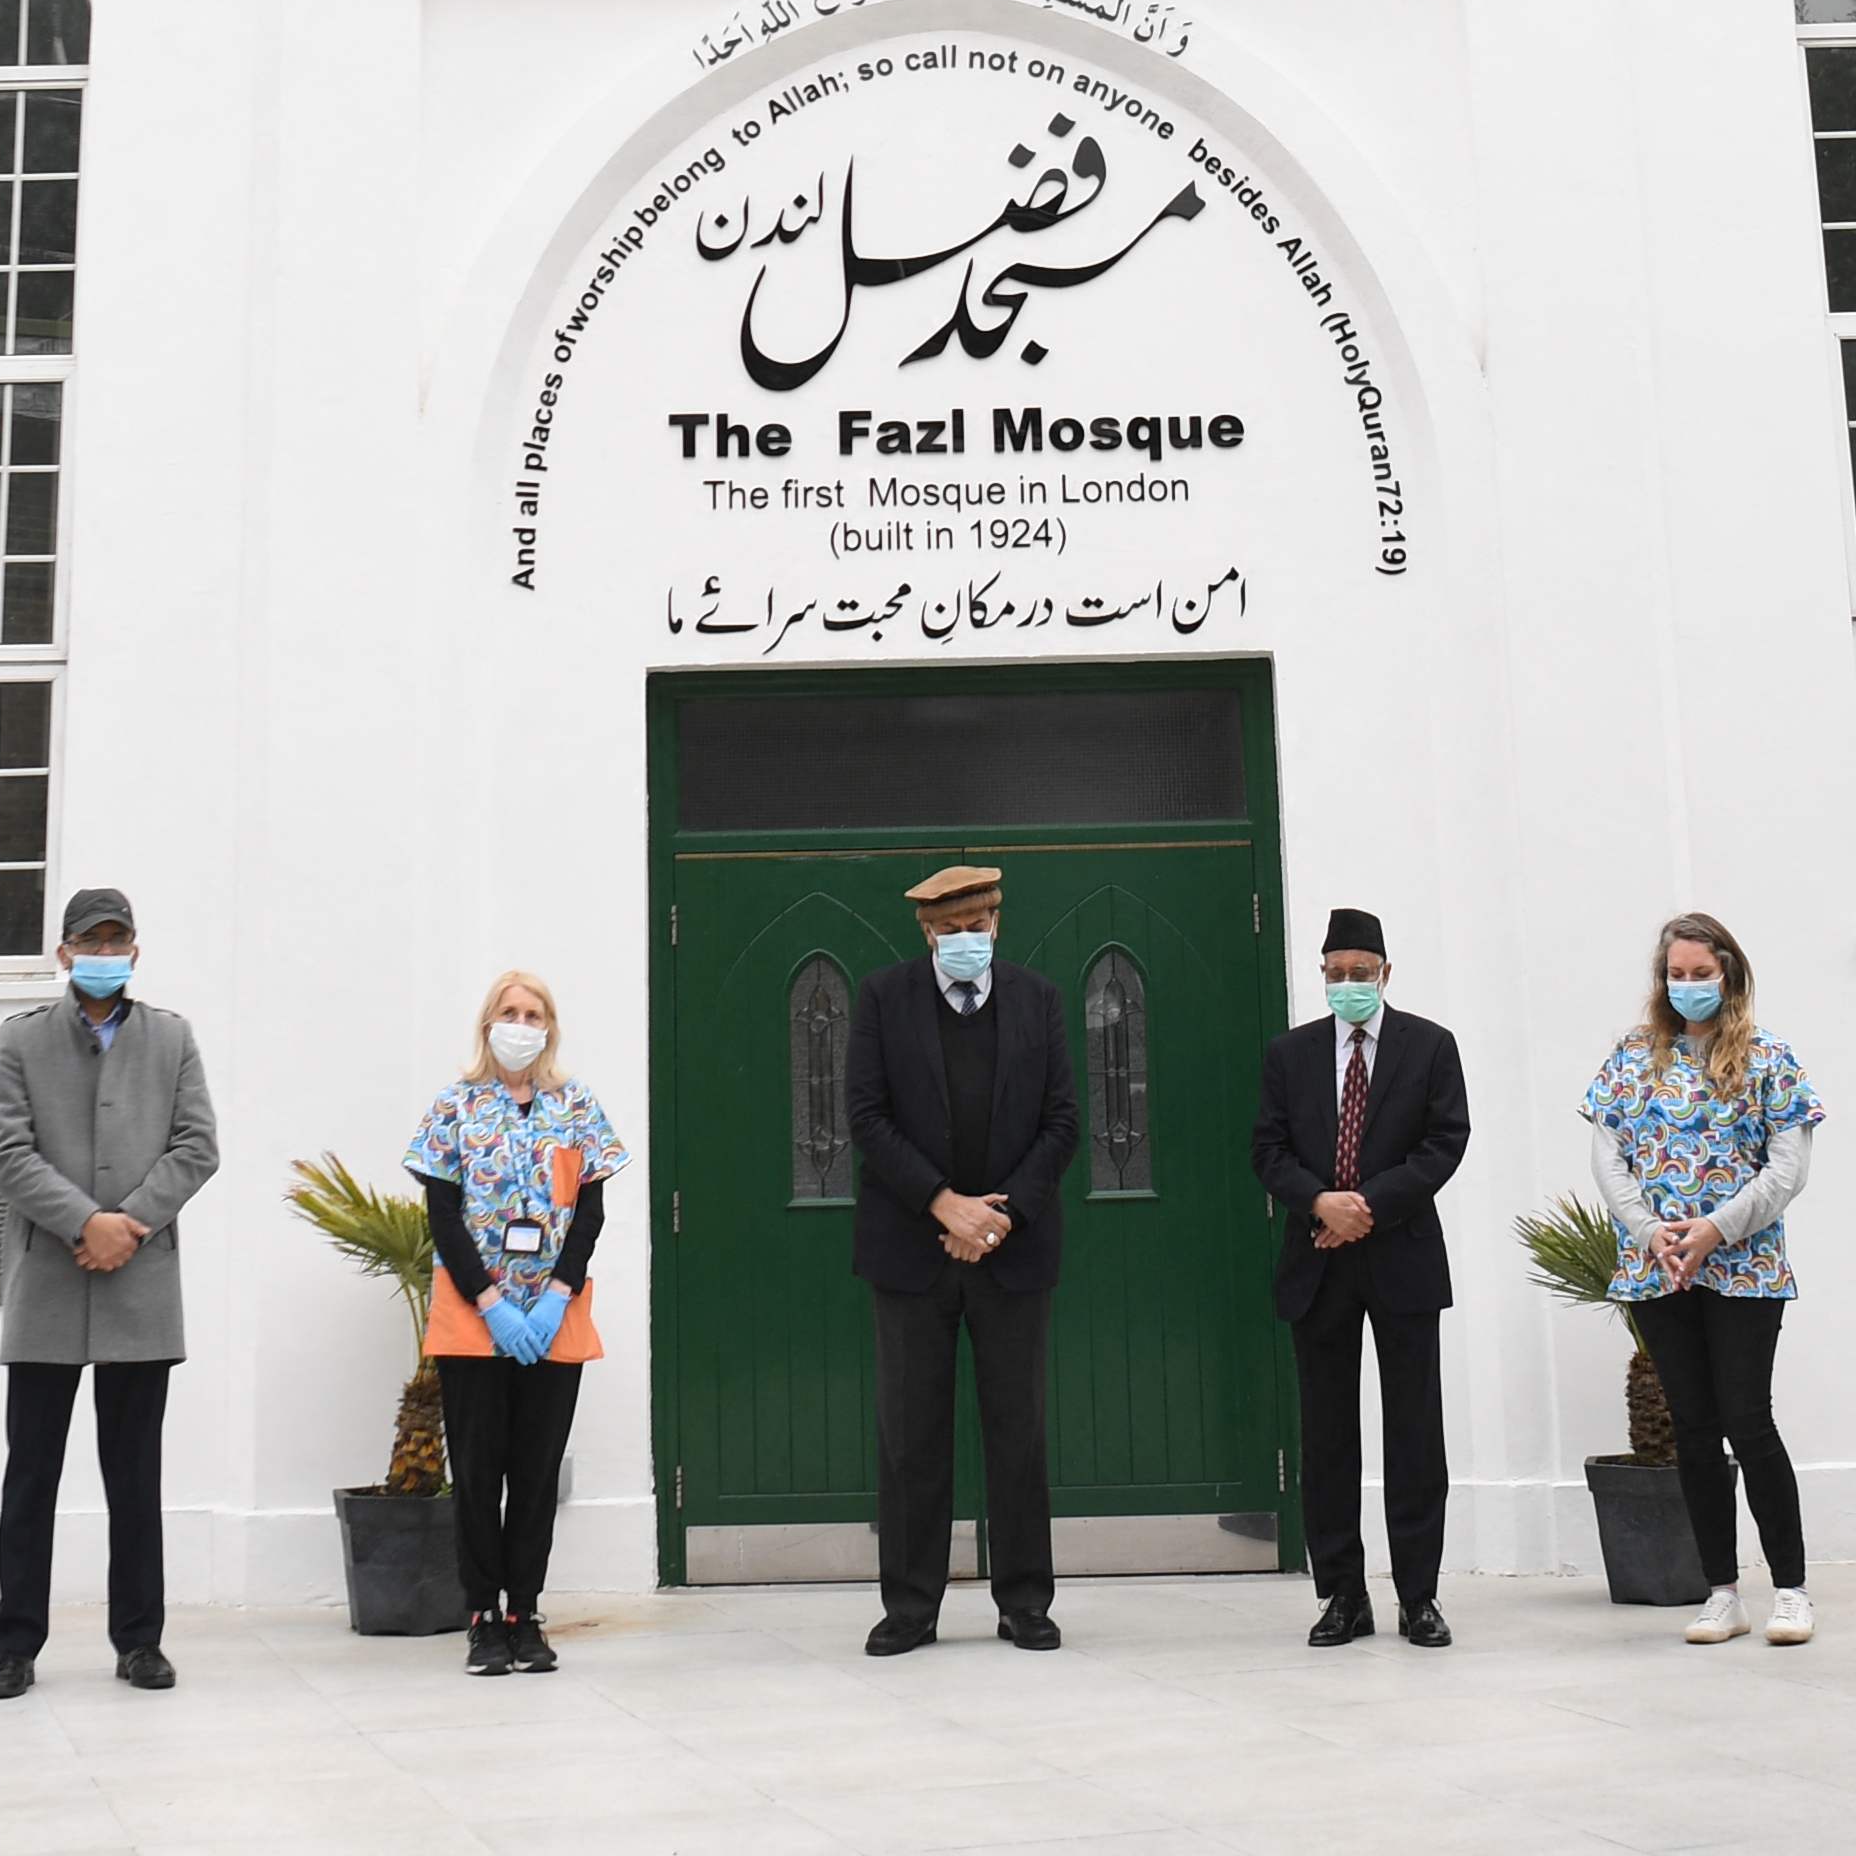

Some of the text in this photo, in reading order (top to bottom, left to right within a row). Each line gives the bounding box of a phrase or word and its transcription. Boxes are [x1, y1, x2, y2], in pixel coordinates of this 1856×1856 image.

[857, 58, 894, 82] so
[904, 44, 957, 72] call
[968, 51, 1018, 74] not
[1027, 60, 1065, 85] on
[768, 71, 849, 125] Allah;
[1073, 74, 1175, 140] anyone
[731, 120, 761, 147] to
[1187, 137, 1280, 235] besides
[1276, 237, 1332, 308] Allah
[522, 373, 563, 472] places
[668, 407, 1245, 463] The Fazl Mosque
[515, 481, 540, 517] all
[702, 472, 1189, 513] The first Mosque in London
[511, 527, 537, 591] And
[830, 517, 1067, 560] (built in 1924)
[1065, 580, 1162, 628] است
[1171, 566, 1246, 635] امن
